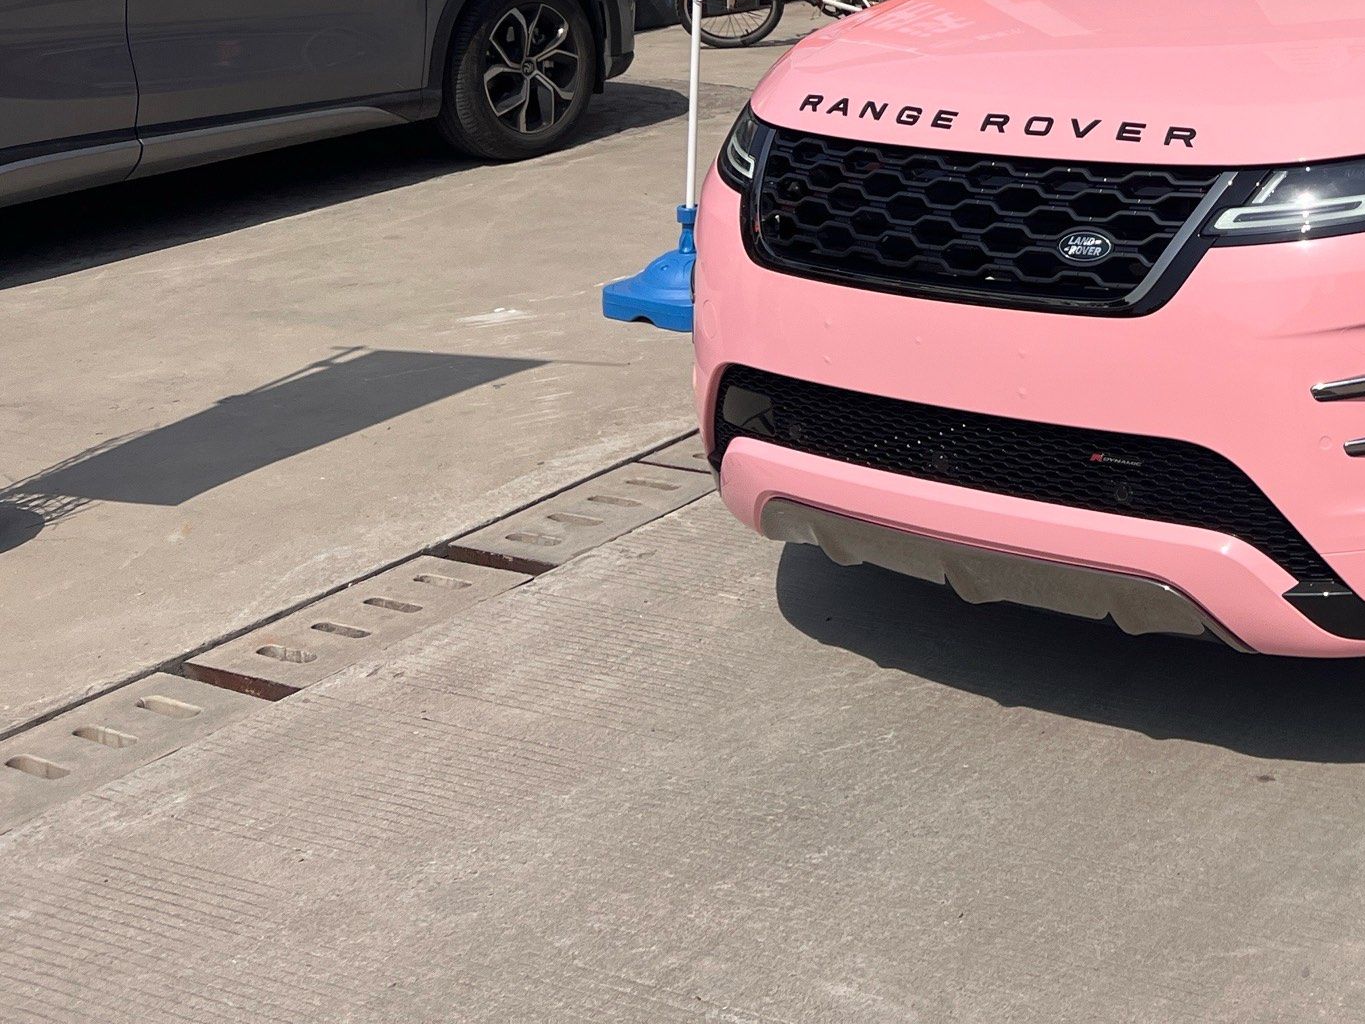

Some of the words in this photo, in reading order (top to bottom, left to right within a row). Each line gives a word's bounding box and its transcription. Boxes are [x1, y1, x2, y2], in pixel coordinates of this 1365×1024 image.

[799, 94, 959, 130] RANGE
[980, 113, 1197, 148] ROVER
[1068, 236, 1097, 246] LAND
[1067, 245, 1102, 257] ROVER
